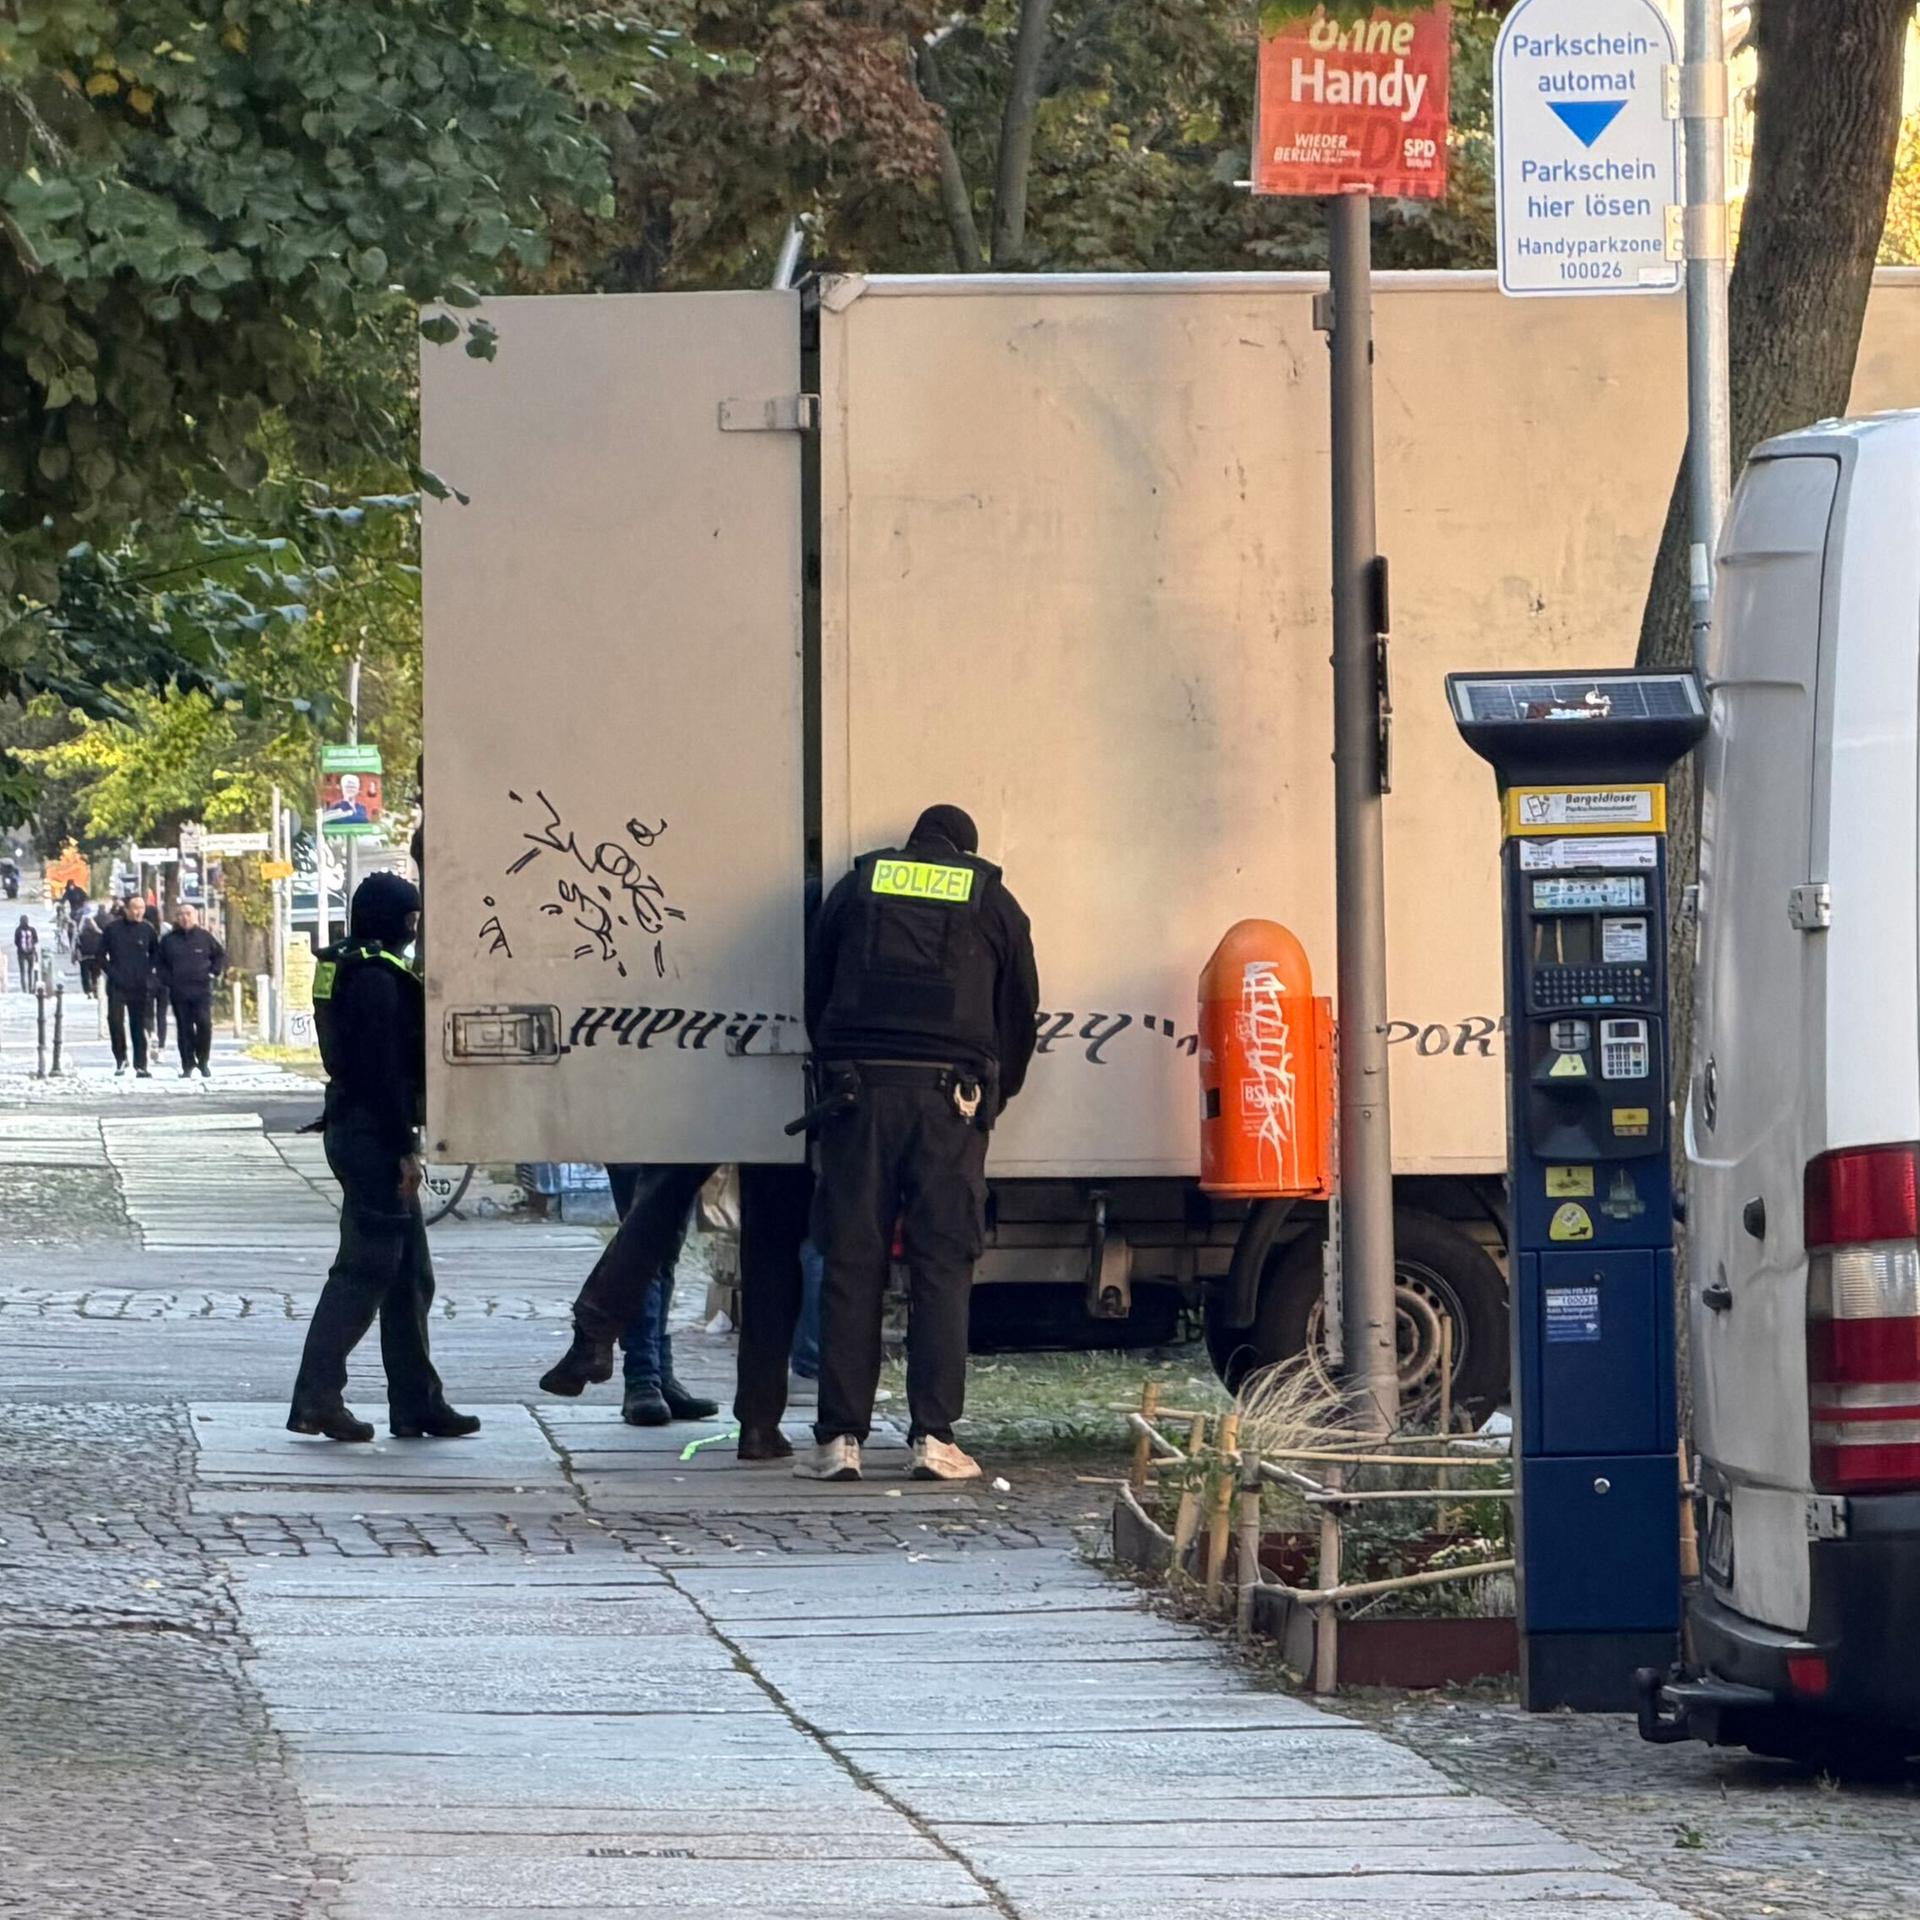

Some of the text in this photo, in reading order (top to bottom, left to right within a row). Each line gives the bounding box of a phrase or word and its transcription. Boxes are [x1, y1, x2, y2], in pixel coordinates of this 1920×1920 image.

[1512, 32, 1660, 57] Parkschein-
[1291, 58, 1428, 122] Handy
[1538, 69, 1637, 92] automat
[1294, 133, 1349, 149] WIEDER
[1403, 138, 1436, 158] SPD
[1273, 146, 1322, 163] BERLIN
[1521, 158, 1656, 183] Parkschein
[1528, 193, 1651, 218] hier lösen
[1517, 236, 1663, 258] Handyparkzone
[1560, 262, 1623, 280] 100026
[1565, 793, 1637, 806] Bargeldloser
[876, 864, 969, 898] POLIZEI
